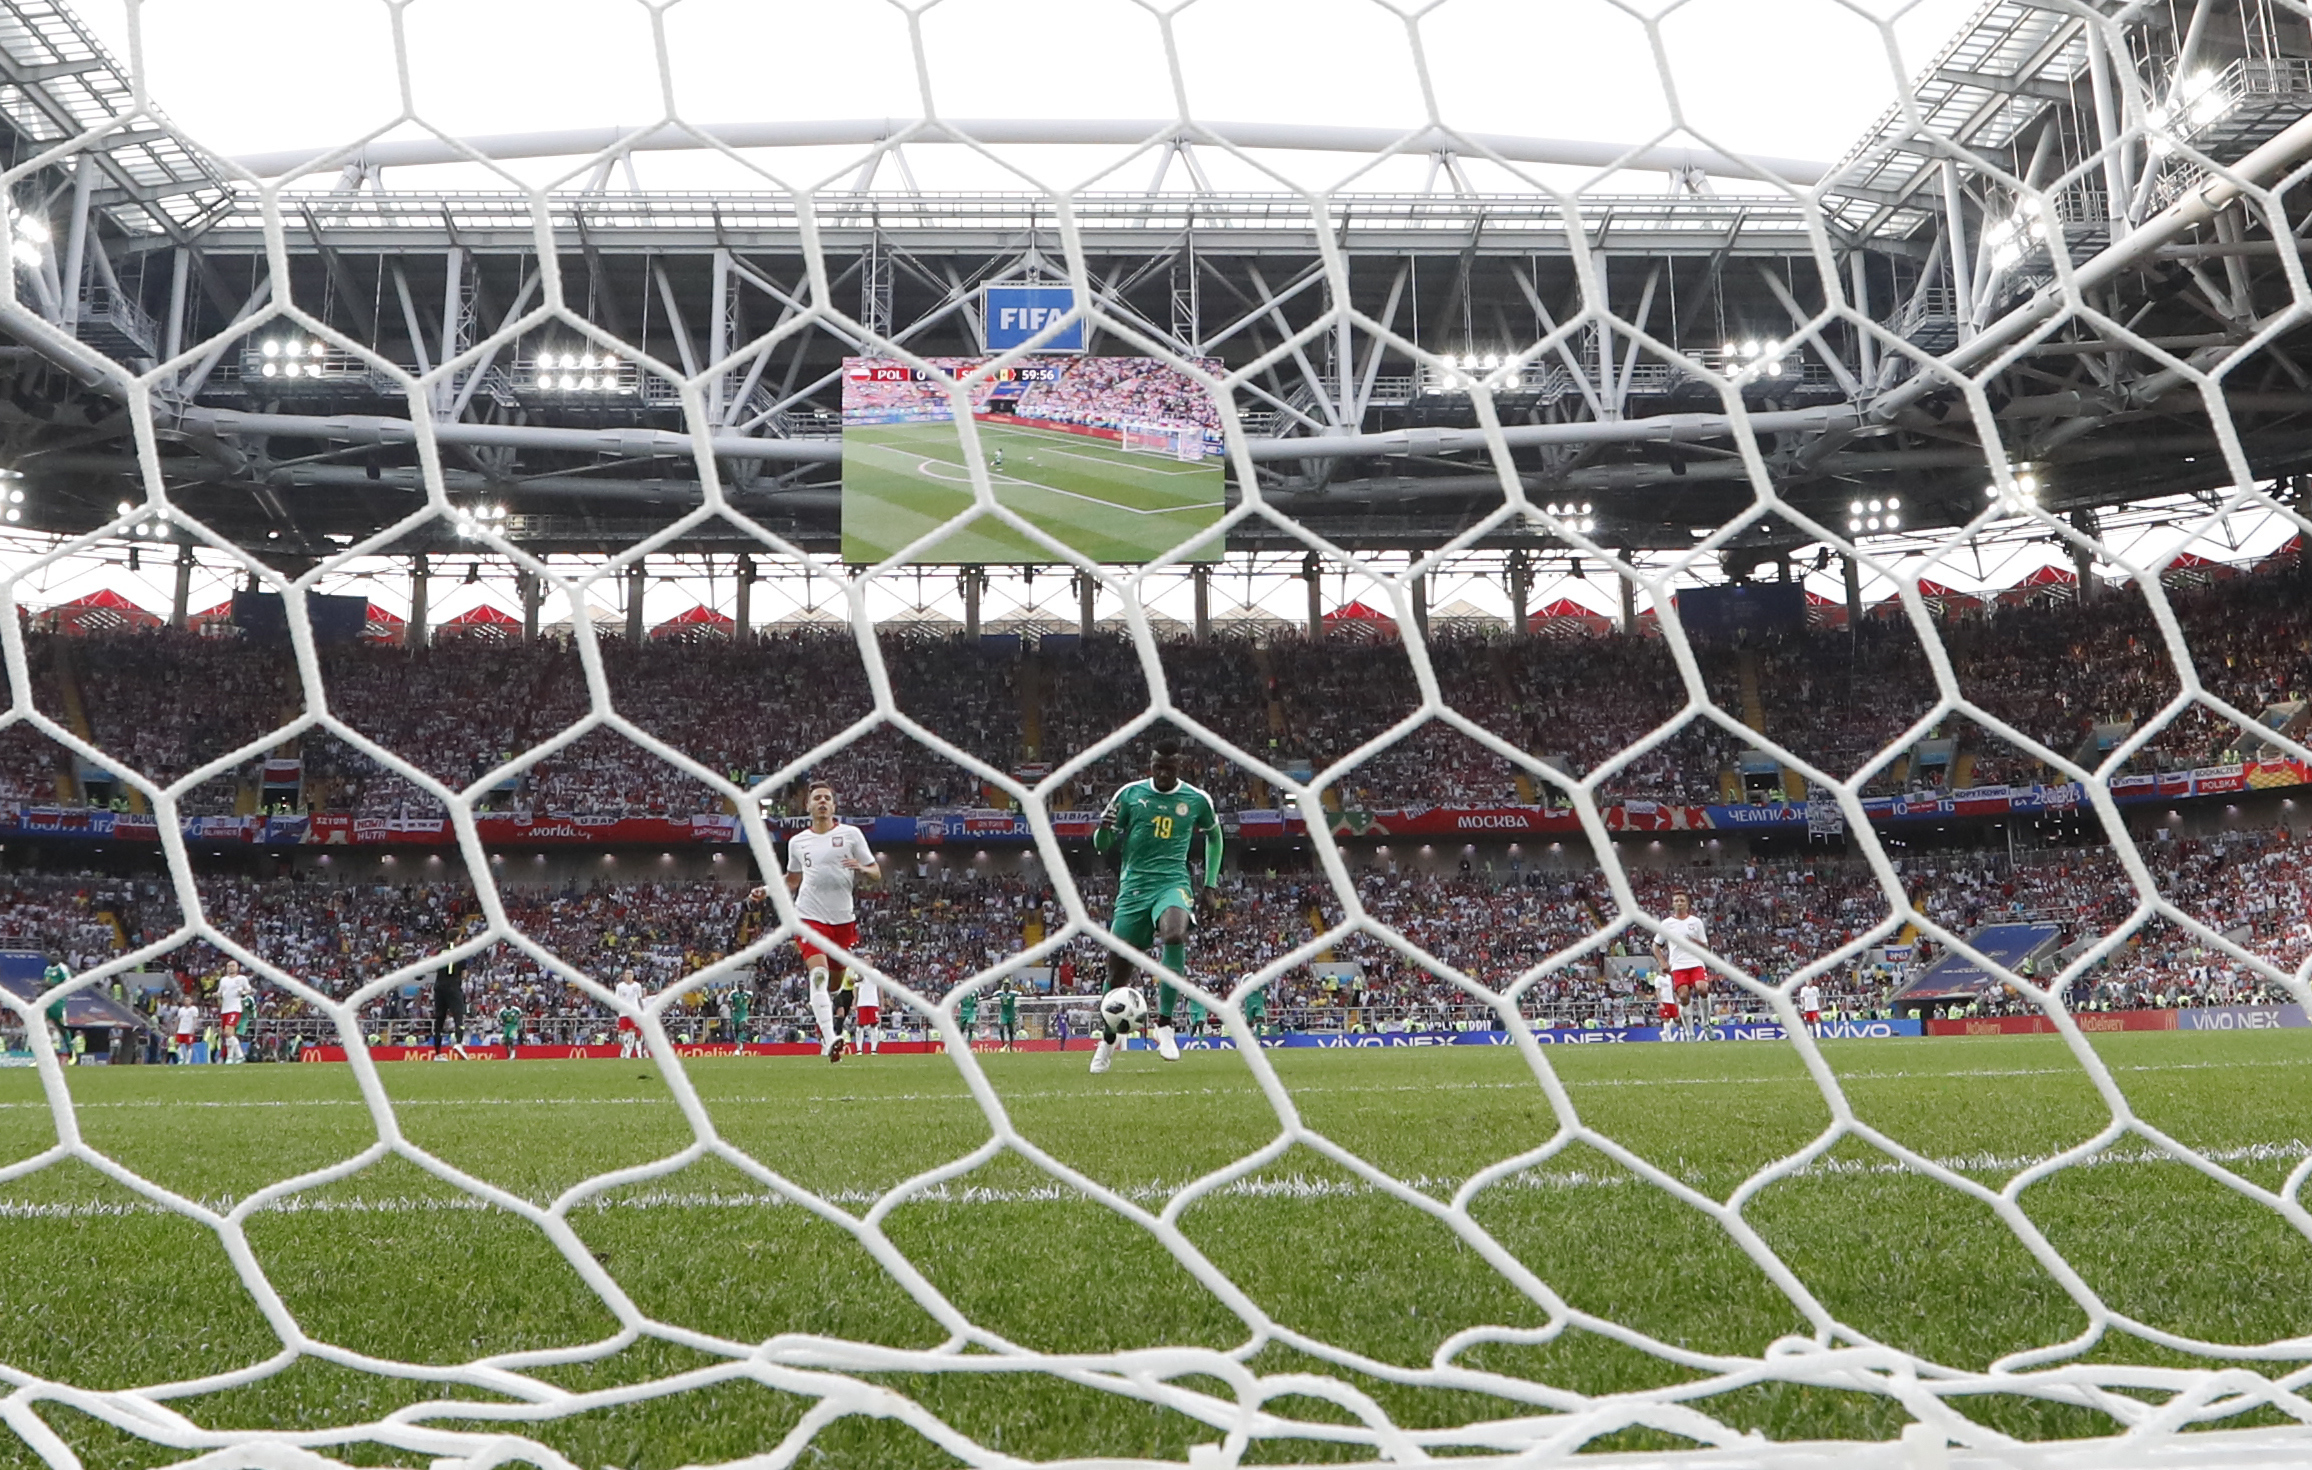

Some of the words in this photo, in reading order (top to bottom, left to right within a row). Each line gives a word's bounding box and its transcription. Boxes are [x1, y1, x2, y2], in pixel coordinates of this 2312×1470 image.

[877, 369, 903, 380] POL
[1022, 369, 1054, 380] 59:56
[2202, 779, 2237, 790] POLSKA
[1152, 816, 1173, 839] 19
[1458, 815, 1529, 828] МОСКВА
[357, 831, 386, 841] HUTA
[803, 852, 812, 868] 5
[2080, 1016, 2124, 1032] McDelivery
[2238, 1011, 2280, 1030] NEX
[1966, 1020, 2001, 1035] McDelivery
[1393, 1036, 1458, 1047] NEX
[1564, 1032, 1628, 1044] NEX
